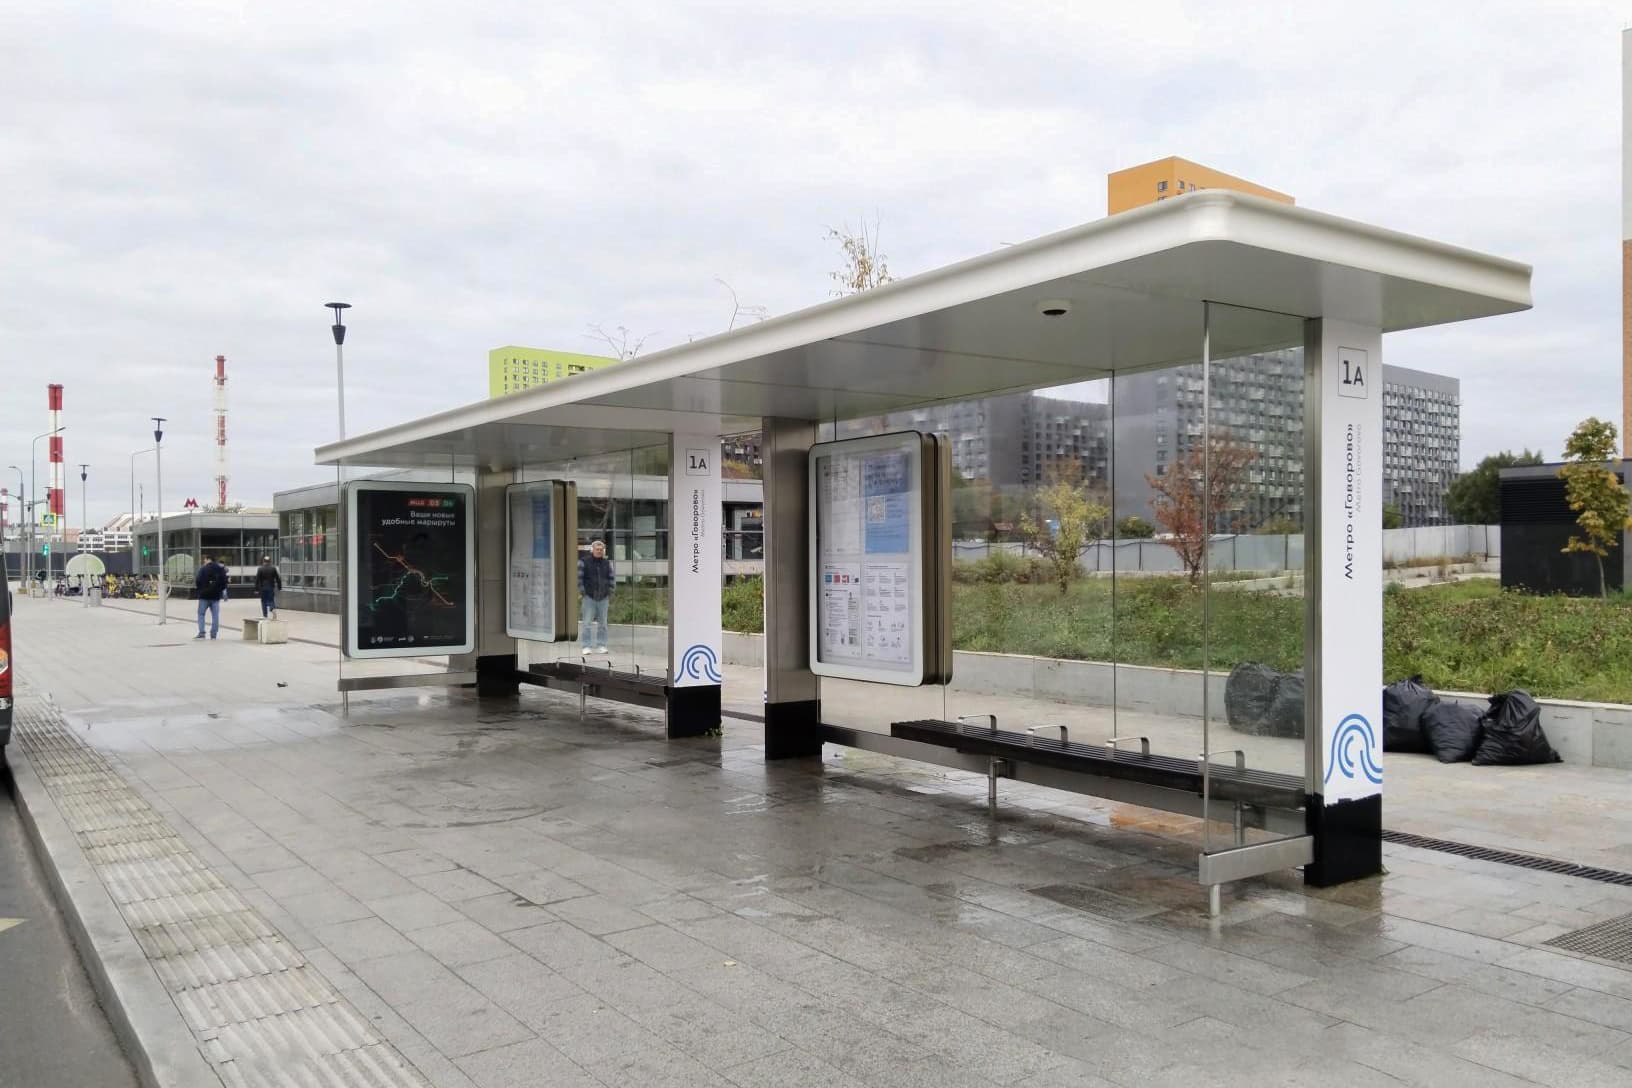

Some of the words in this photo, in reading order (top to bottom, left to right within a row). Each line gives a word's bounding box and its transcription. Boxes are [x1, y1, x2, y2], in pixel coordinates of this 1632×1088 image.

[1345, 423, 1355, 519] «Говорово»
[381, 518, 415, 526] удобные
[692, 543, 700, 574] Метро
[1345, 524, 1355, 580] Метро
